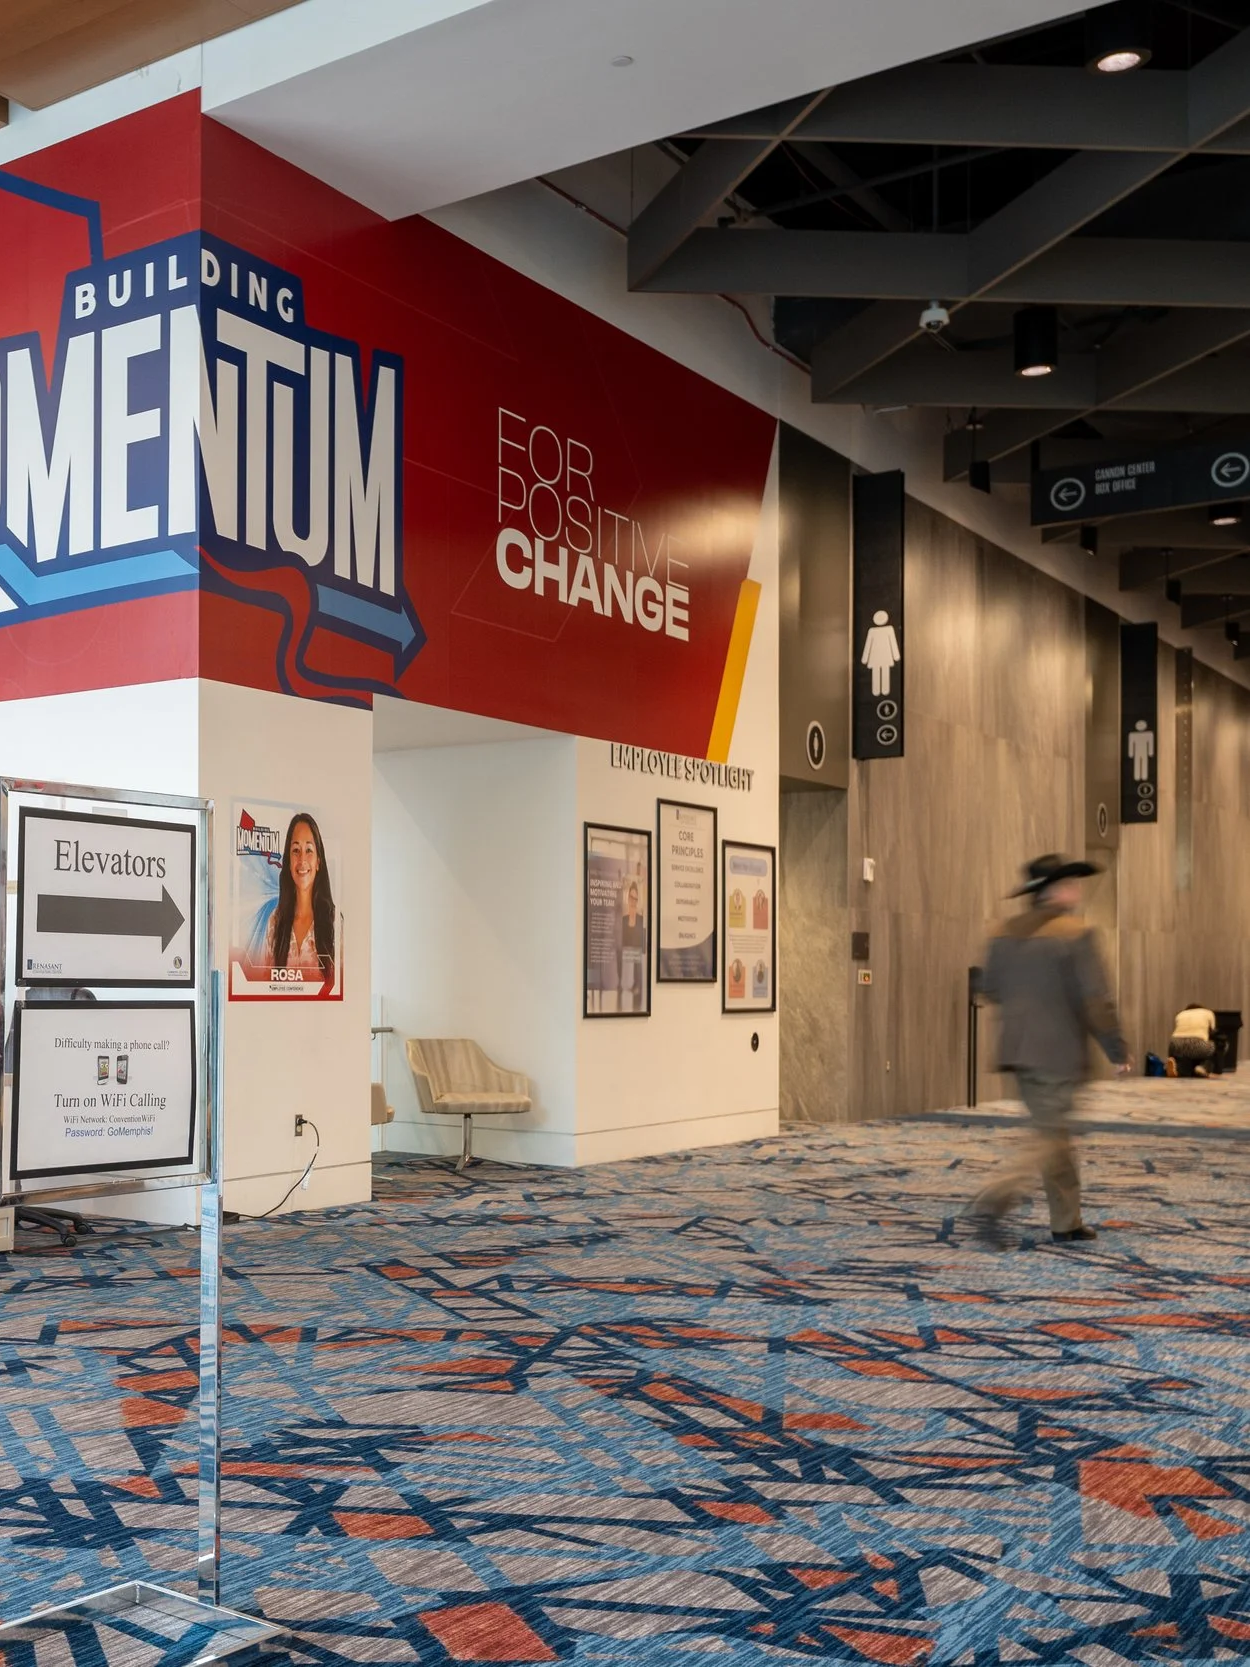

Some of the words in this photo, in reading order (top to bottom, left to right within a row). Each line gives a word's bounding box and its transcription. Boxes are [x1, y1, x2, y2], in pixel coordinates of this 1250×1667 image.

[75, 248, 294, 323] BUILDING
[499, 407, 594, 502] FOR
[1095, 465, 1125, 481] CANNON
[1127, 460, 1155, 476] CENTER
[1095, 482, 1110, 495] BOX
[1112, 477, 1136, 493] OFFICE
[498, 466, 689, 591] POSITIVE
[496, 527, 689, 642] CHANGE
[610, 742, 681, 780] EMPLOYEE
[684, 755, 754, 792] SPOTLIGHT
[237, 827, 279, 854] MOMENTUM
[678, 830, 694, 842] CORE
[54, 840, 166, 878] Elevators
[671, 844, 704, 858] PRINCIPLES
[33, 962, 63, 970] RENASANT
[271, 969, 303, 981] ROSA
[54, 1038, 92, 1051] Difficulty
[94, 1038, 122, 1051] making
[130, 1040, 151, 1052] phone
[153, 1040, 170, 1050] call?
[54, 1094, 80, 1107] Turn
[83, 1097, 97, 1107] on
[100, 1093, 127, 1107] WiFi
[130, 1093, 166, 1110] Calling
[63, 1115, 79, 1124] WiFi
[80, 1115, 108, 1124] Network:
[109, 1114, 156, 1123] ConventionWiFi
[65, 1127, 105, 1138] Password:
[107, 1126, 154, 1138] GoMemphis!
